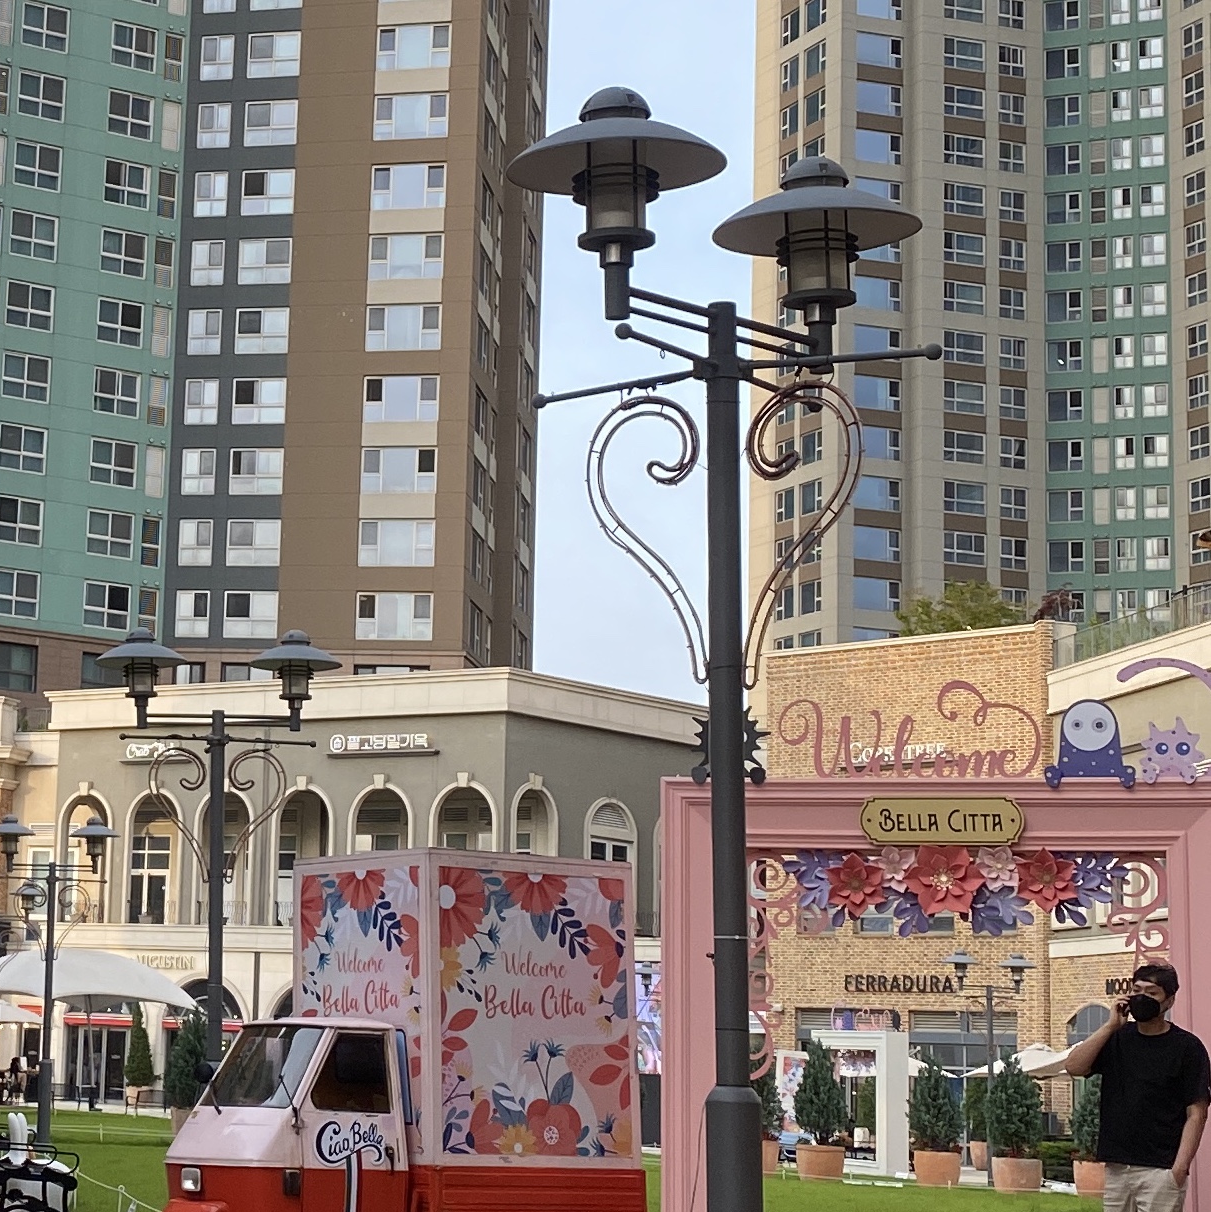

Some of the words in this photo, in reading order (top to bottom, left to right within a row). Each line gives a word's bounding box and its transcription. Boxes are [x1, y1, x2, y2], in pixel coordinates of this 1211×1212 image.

[779, 680, 1040, 778] Welcome
[878, 808, 939, 833] BELLA
[947, 808, 1004, 833] CITTA
[334, 947, 386, 974] Welcome
[501, 946, 567, 979] Welcome
[322, 983, 359, 1018] Bella
[364, 979, 400, 1015] Citta
[844, 974, 954, 993] FERRADURA
[484, 984, 536, 1020] Bella
[541, 984, 587, 1020] Citta
[316, 1120, 350, 1164] Ciao
[349, 1119, 385, 1152] Bella
